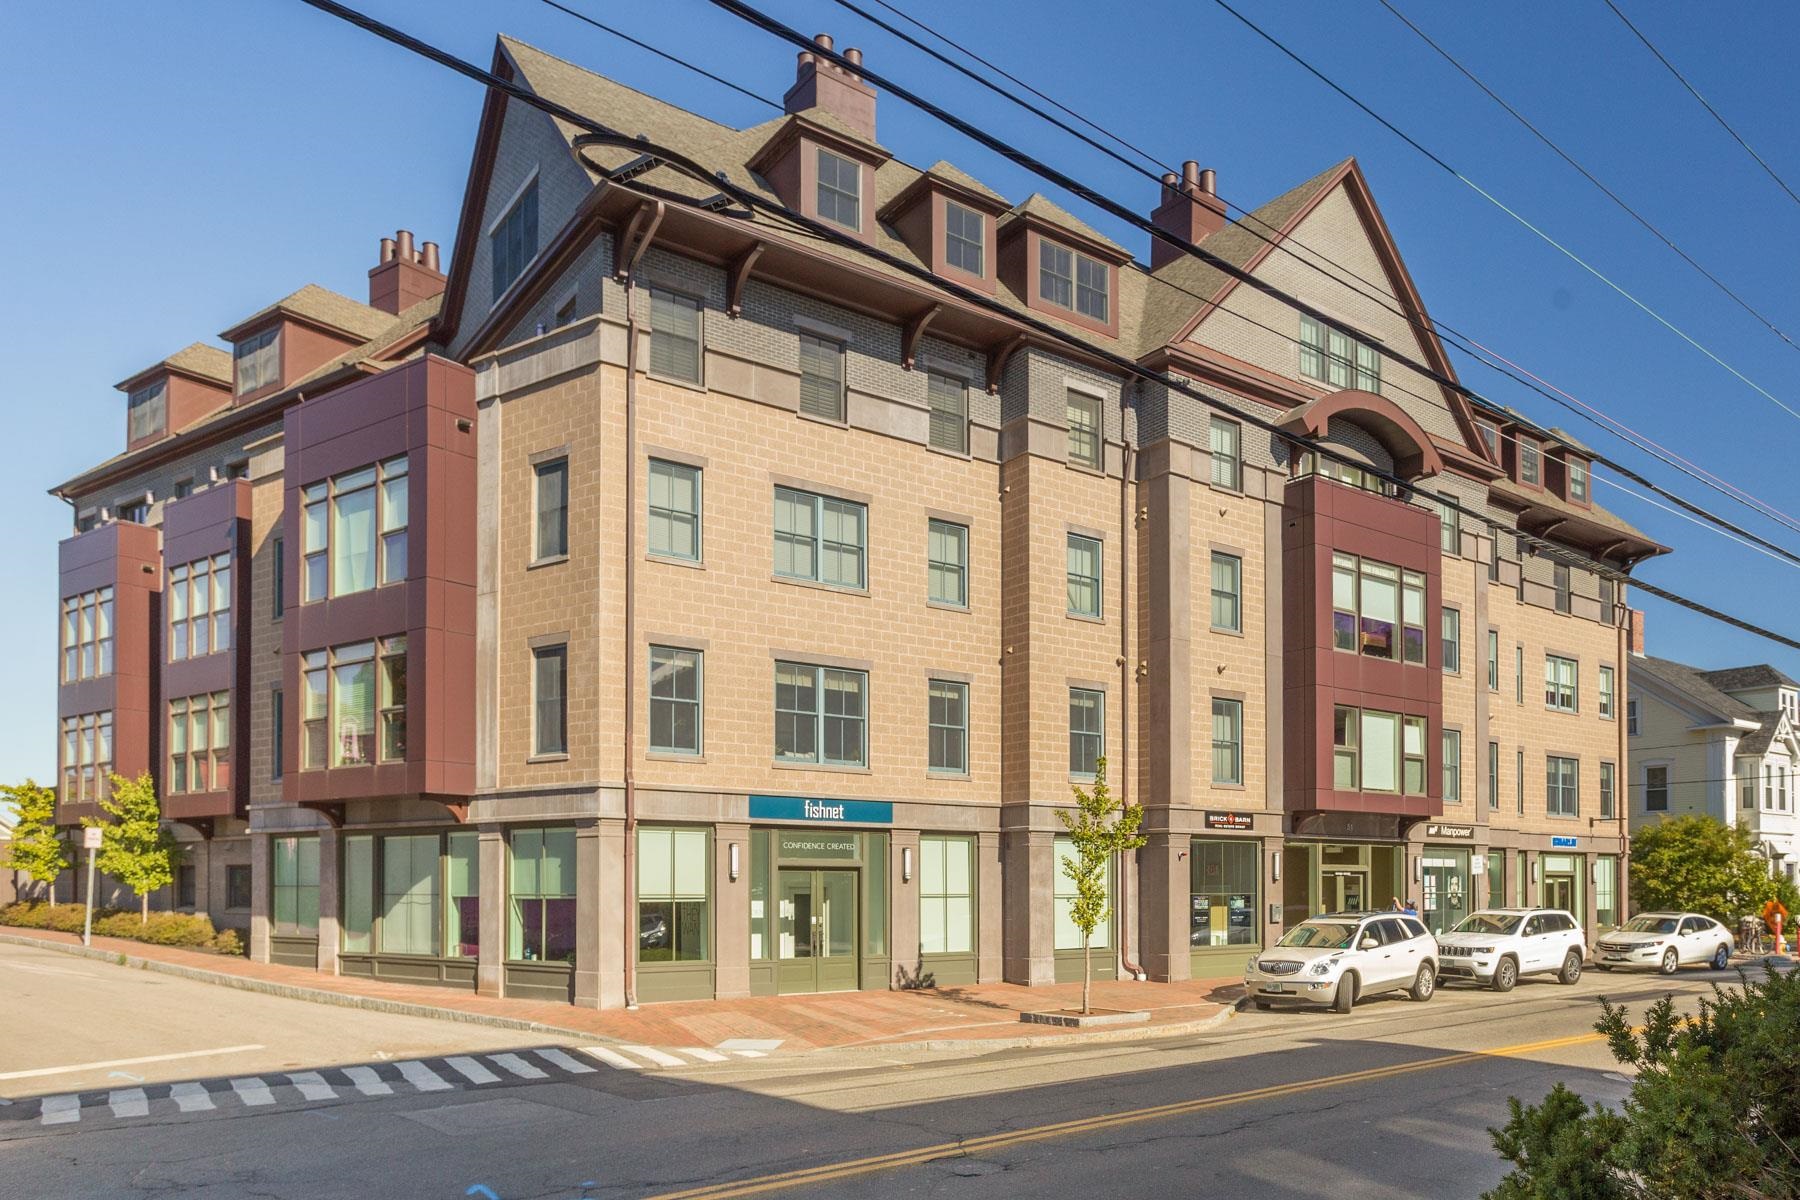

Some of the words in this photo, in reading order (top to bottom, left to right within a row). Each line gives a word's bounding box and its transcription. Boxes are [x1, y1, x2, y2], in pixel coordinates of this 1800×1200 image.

[804, 800, 844, 819] fishnet
[1440, 825, 1472, 838] Manpower
[783, 842, 825, 850] CONFIDENCE
[826, 843, 856, 851] CREATED
